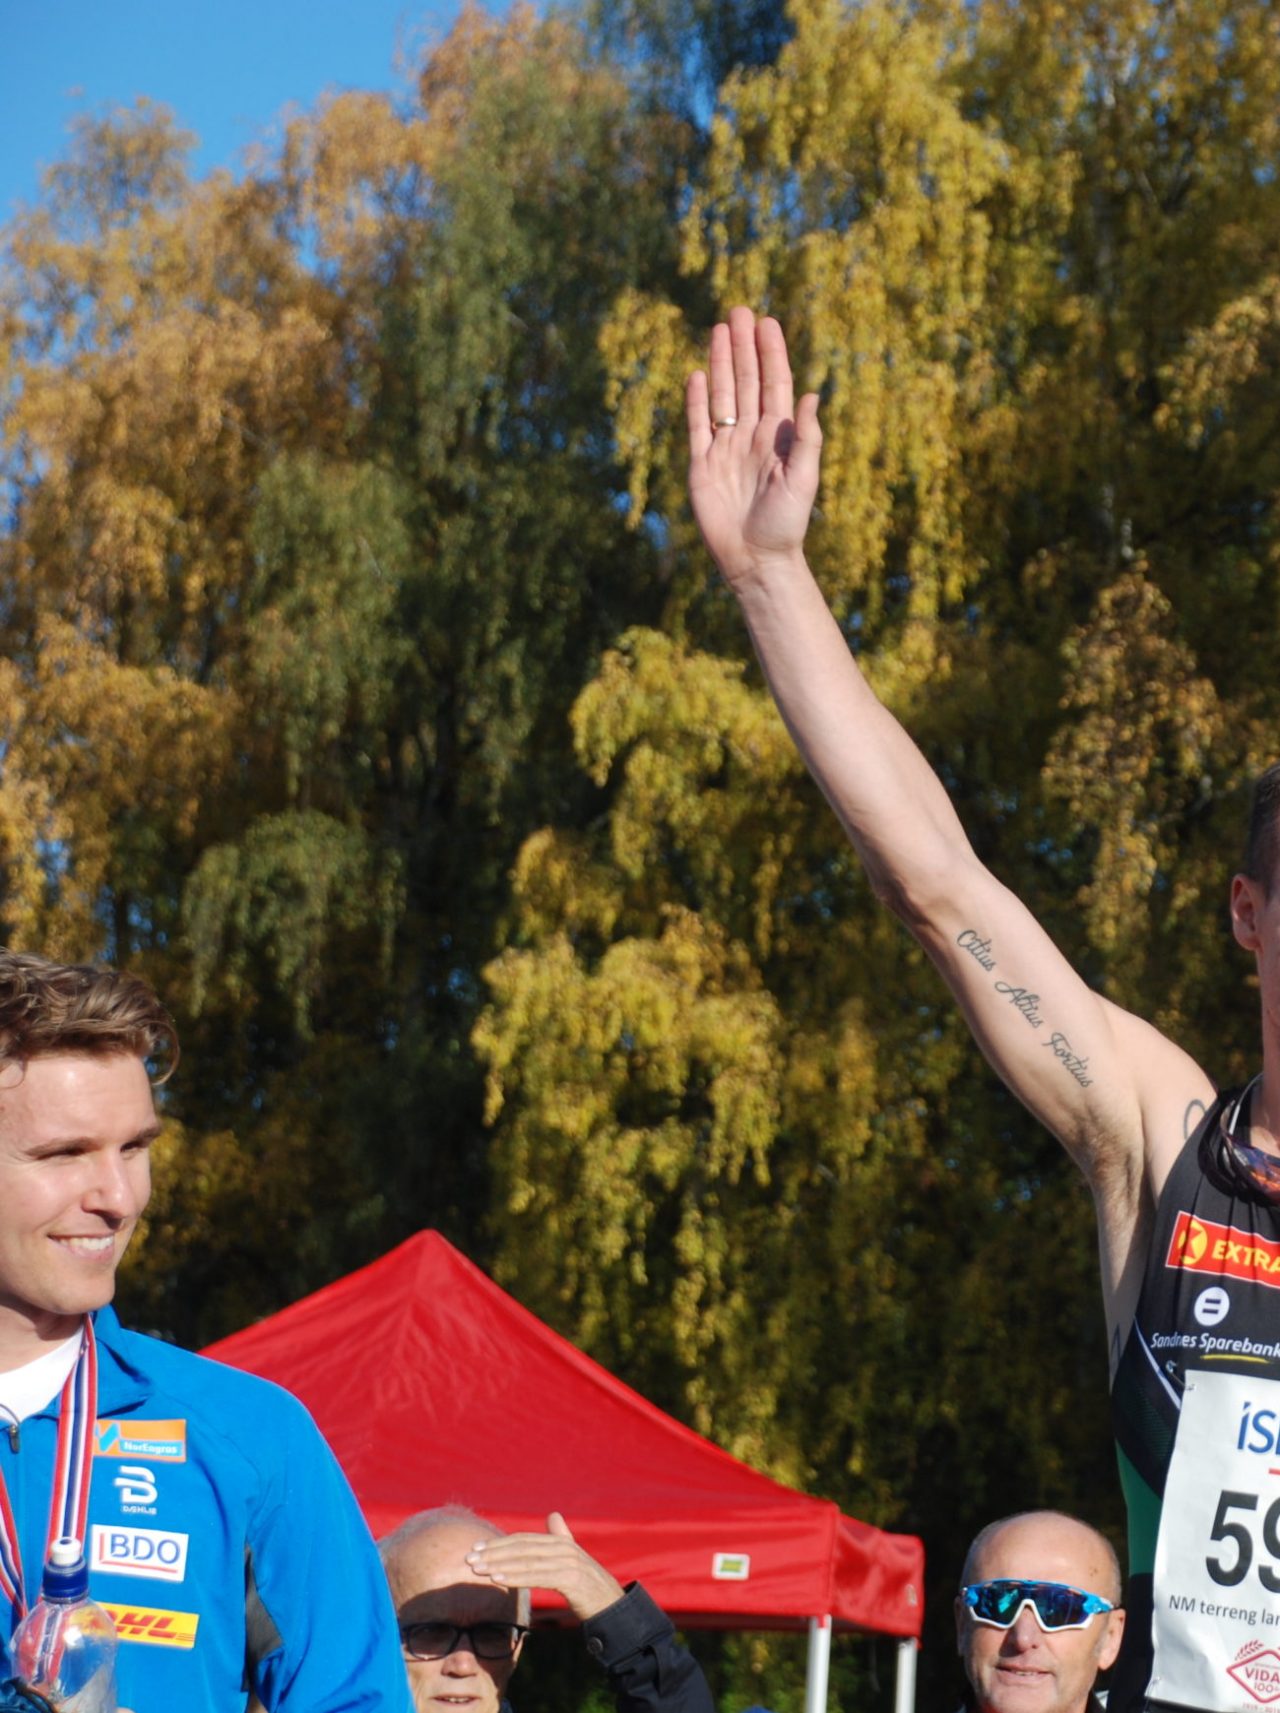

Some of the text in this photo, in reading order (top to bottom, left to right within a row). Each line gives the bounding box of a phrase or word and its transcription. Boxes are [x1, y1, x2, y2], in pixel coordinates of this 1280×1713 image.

[995, 981, 1044, 1028] Altius
[1151, 1332, 1197, 1348] Sandnes
[110, 1533, 181, 1564] BDO
[1169, 1595, 1195, 1612] NM
[1200, 1601, 1256, 1625] terreng
